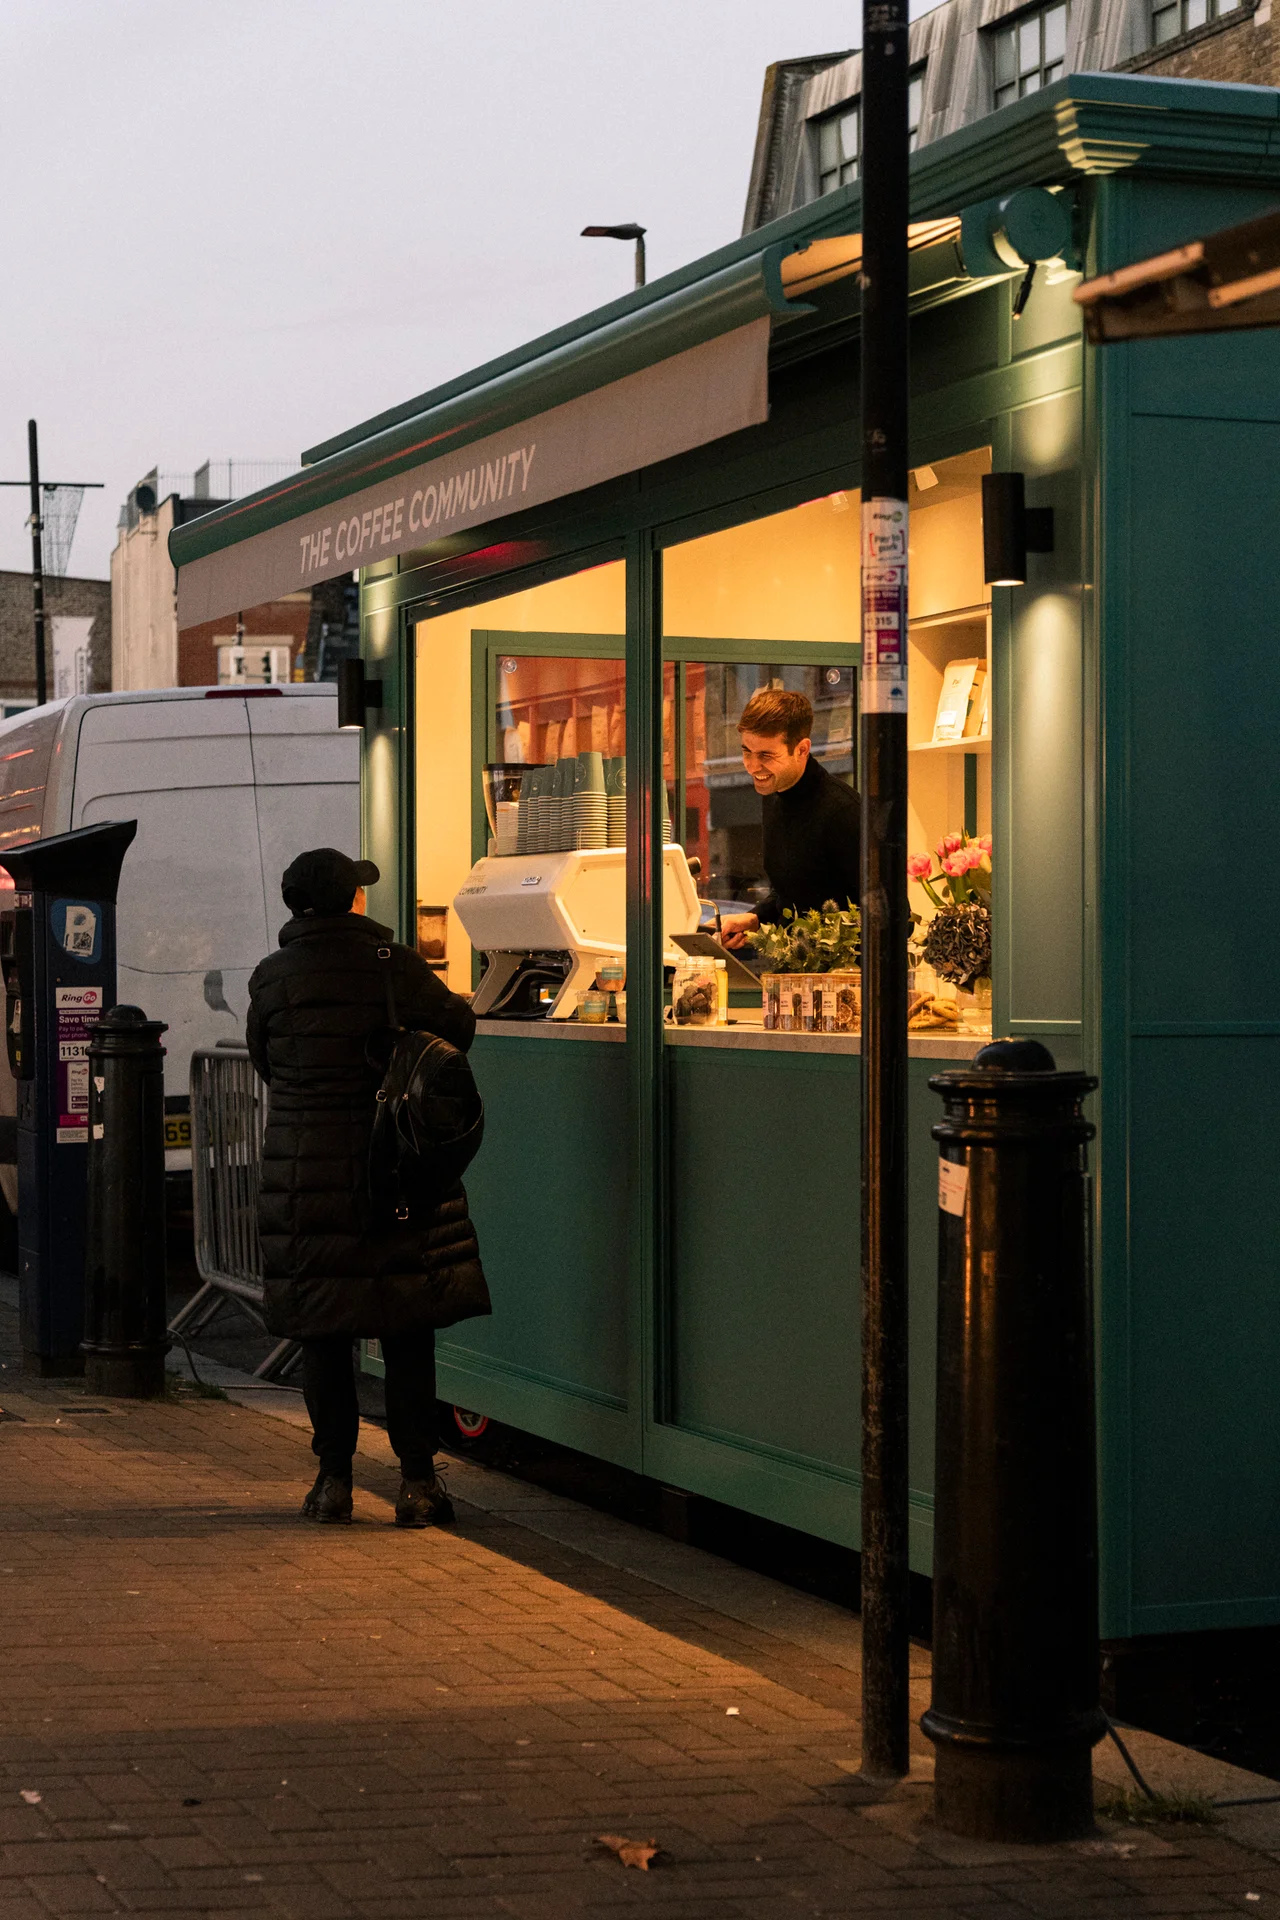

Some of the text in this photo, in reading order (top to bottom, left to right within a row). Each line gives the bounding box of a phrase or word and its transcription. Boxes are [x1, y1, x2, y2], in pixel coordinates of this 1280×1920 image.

[300, 444, 536, 574] THE COFFEE COMMUNITY
[61, 991, 97, 1004] RingGo
[59, 1015, 99, 1024] Save time
